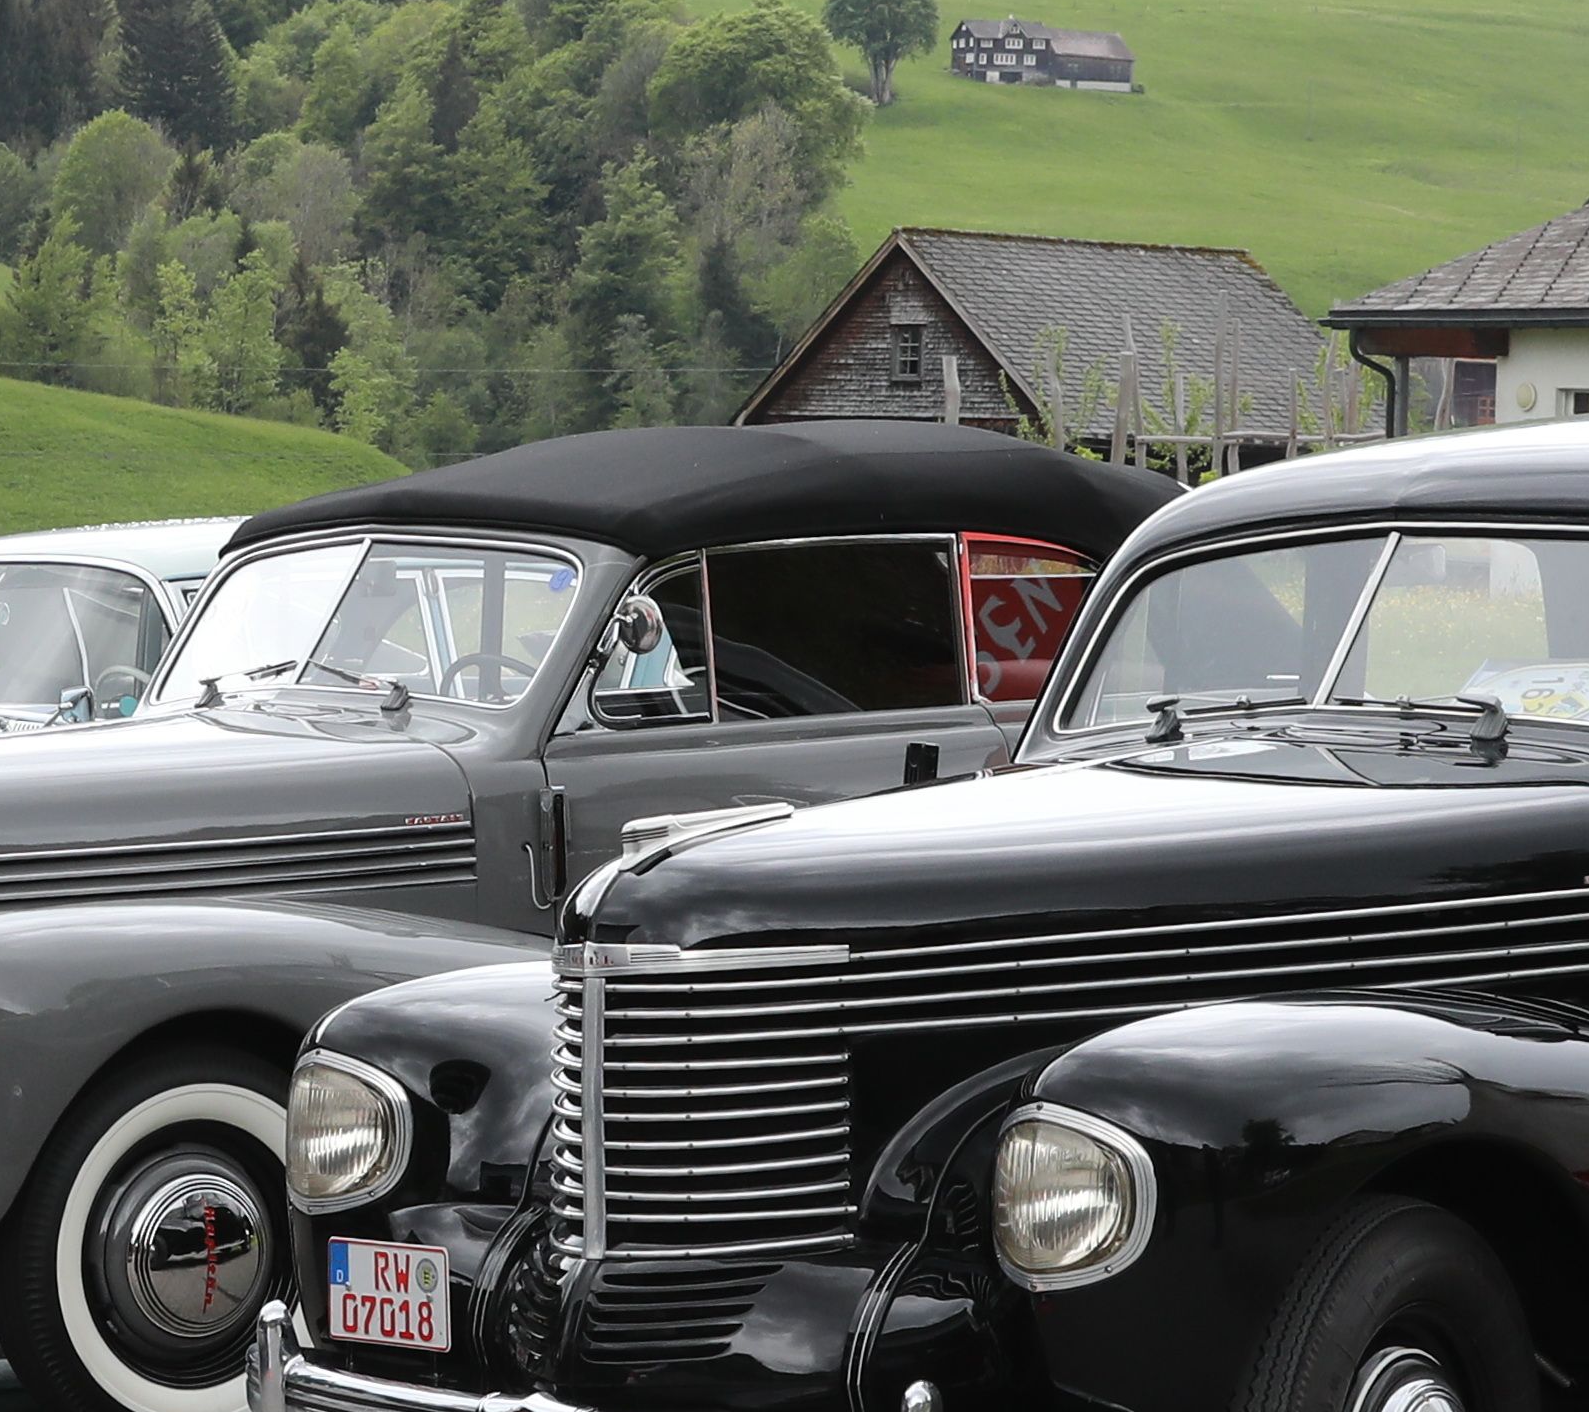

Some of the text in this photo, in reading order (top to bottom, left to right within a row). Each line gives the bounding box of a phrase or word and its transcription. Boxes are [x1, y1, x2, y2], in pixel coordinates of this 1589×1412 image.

[336, 1269, 344, 1283] D
[374, 1251, 410, 1294] RW
[342, 1293, 434, 1342] 07018
